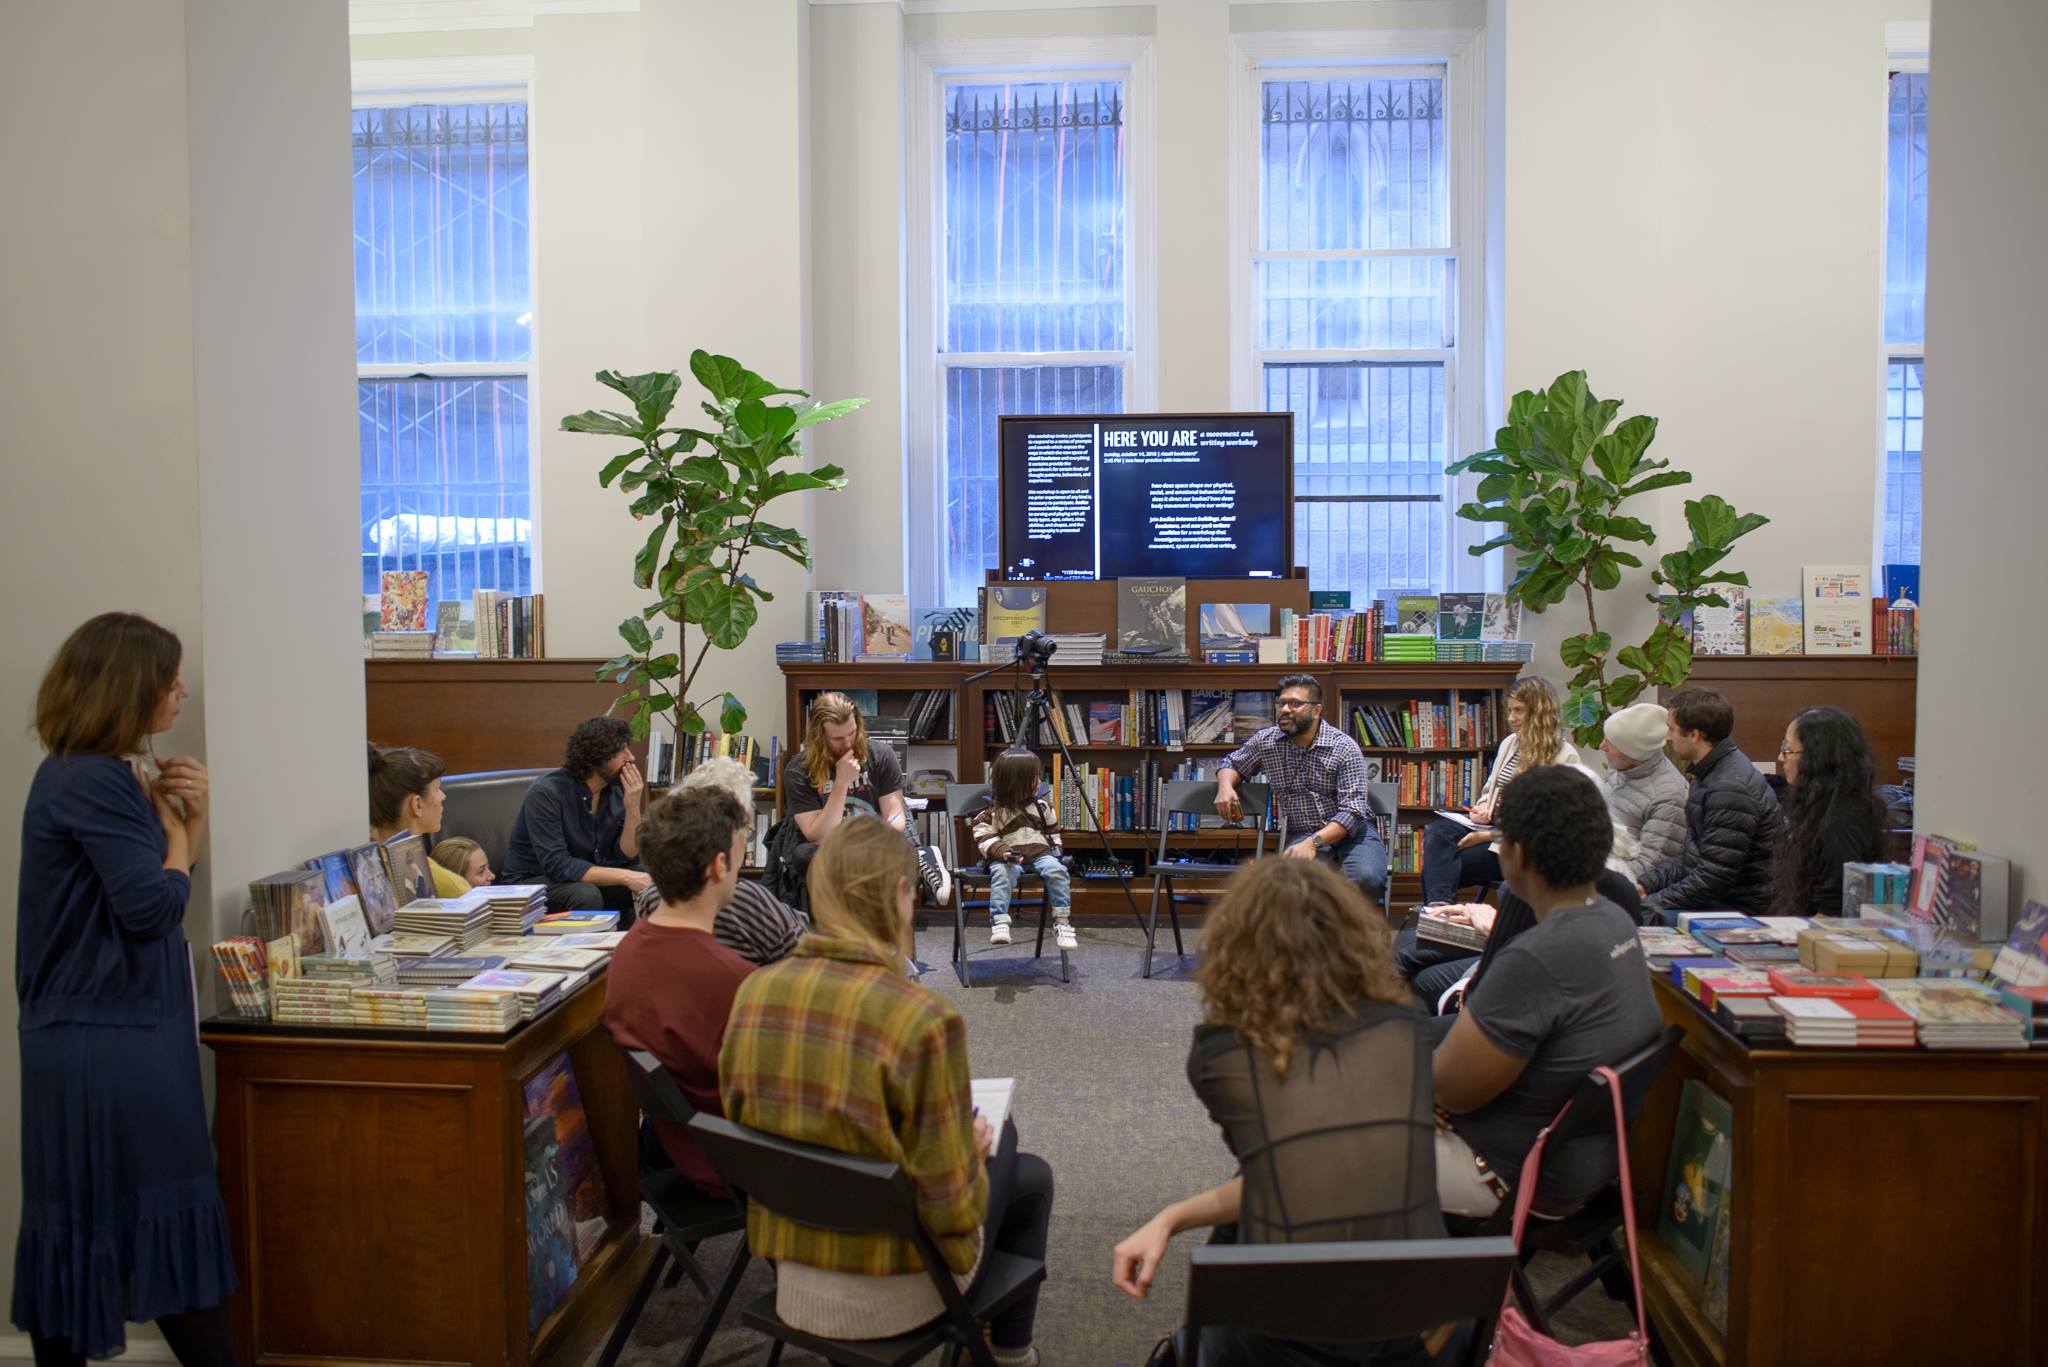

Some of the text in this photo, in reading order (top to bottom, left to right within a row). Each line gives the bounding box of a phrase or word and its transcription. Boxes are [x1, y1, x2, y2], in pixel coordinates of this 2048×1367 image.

[1104, 431, 1197, 447] HERE YOU ARE
[1226, 439, 1258, 447] workshop
[1192, 688, 1232, 698] BARCHE
